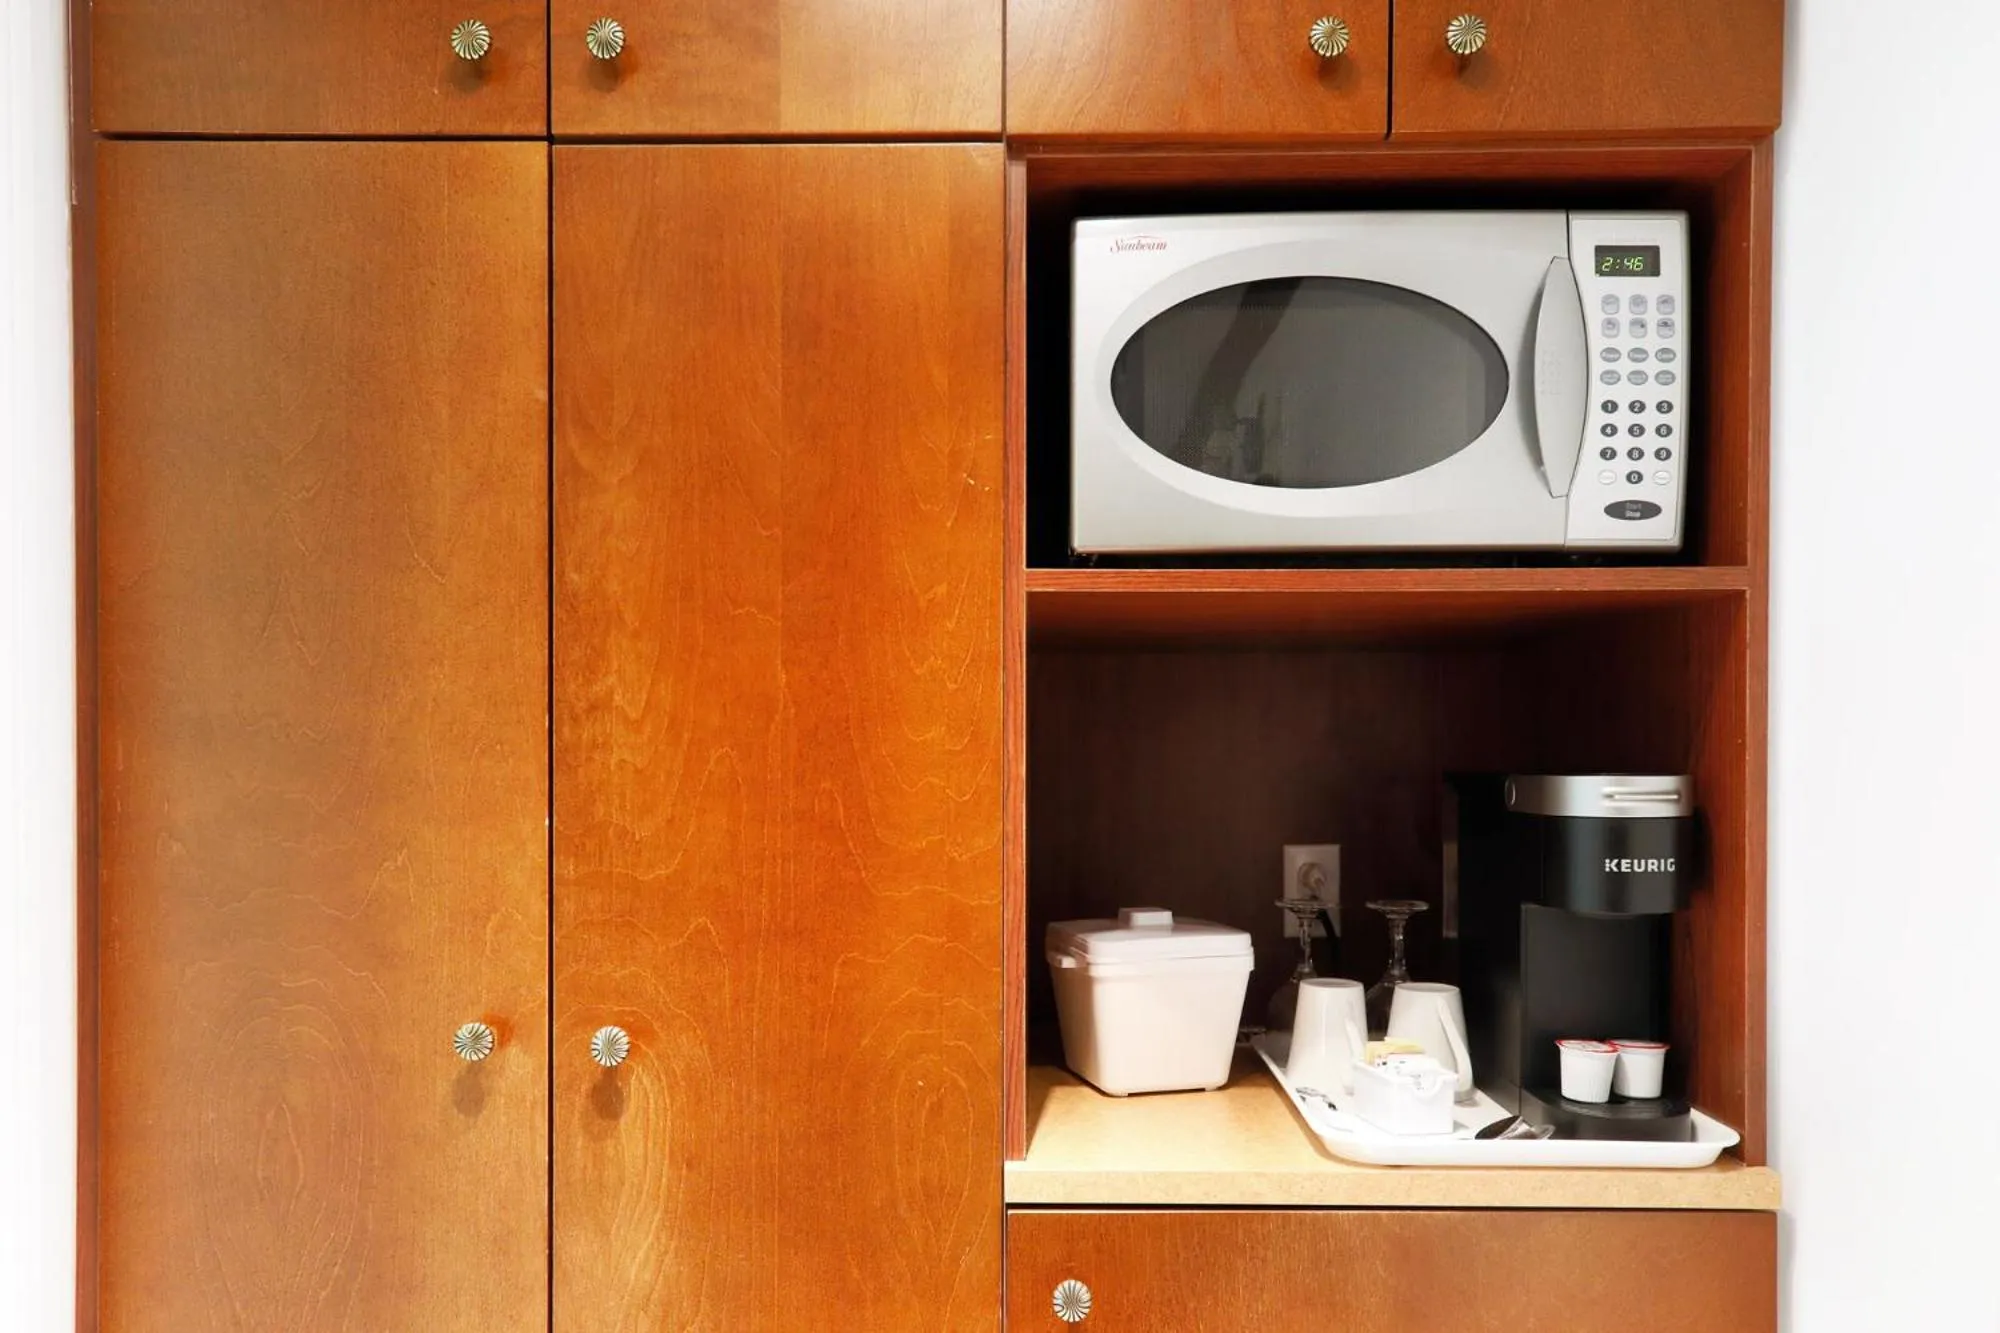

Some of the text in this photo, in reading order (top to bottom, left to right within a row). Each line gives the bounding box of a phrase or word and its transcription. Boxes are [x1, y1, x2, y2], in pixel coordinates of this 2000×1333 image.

[1109, 238, 1168, 252] Sunbeam
[1601, 256, 1644, 272] 2:46
[1633, 402, 1641, 412] 2
[1661, 402, 1668, 412] 3
[1605, 426, 1667, 436] 4 5 6
[1605, 449, 1667, 460] 7 8 9
[1631, 473, 1638, 482] 0
[1604, 858, 1676, 873] KEURIG
